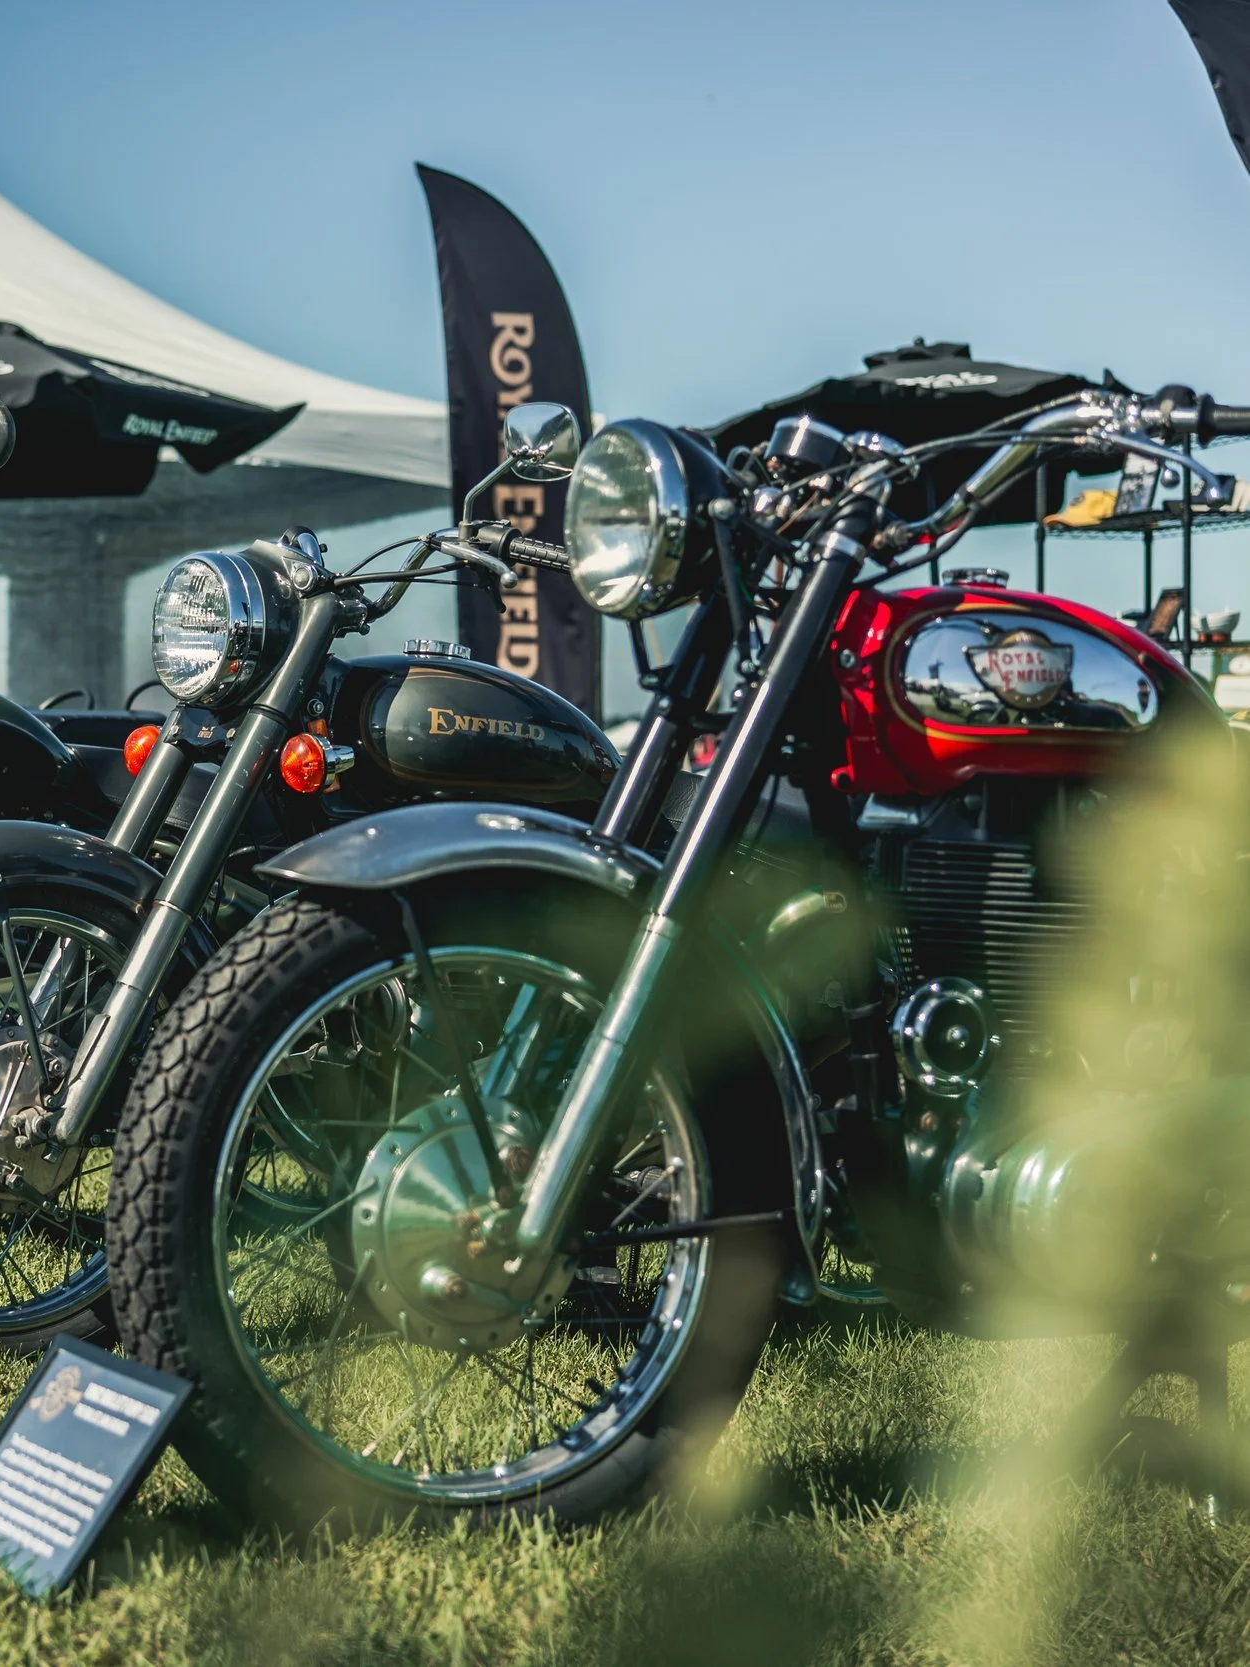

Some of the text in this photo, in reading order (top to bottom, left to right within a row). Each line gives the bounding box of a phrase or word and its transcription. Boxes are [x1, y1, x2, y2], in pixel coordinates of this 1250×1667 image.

[123, 413, 165, 437] ROYAL
[988, 650, 1045, 681] ROYAL
[1002, 669, 1063, 692] ENFIELD
[427, 707, 546, 742] ENFIELD
